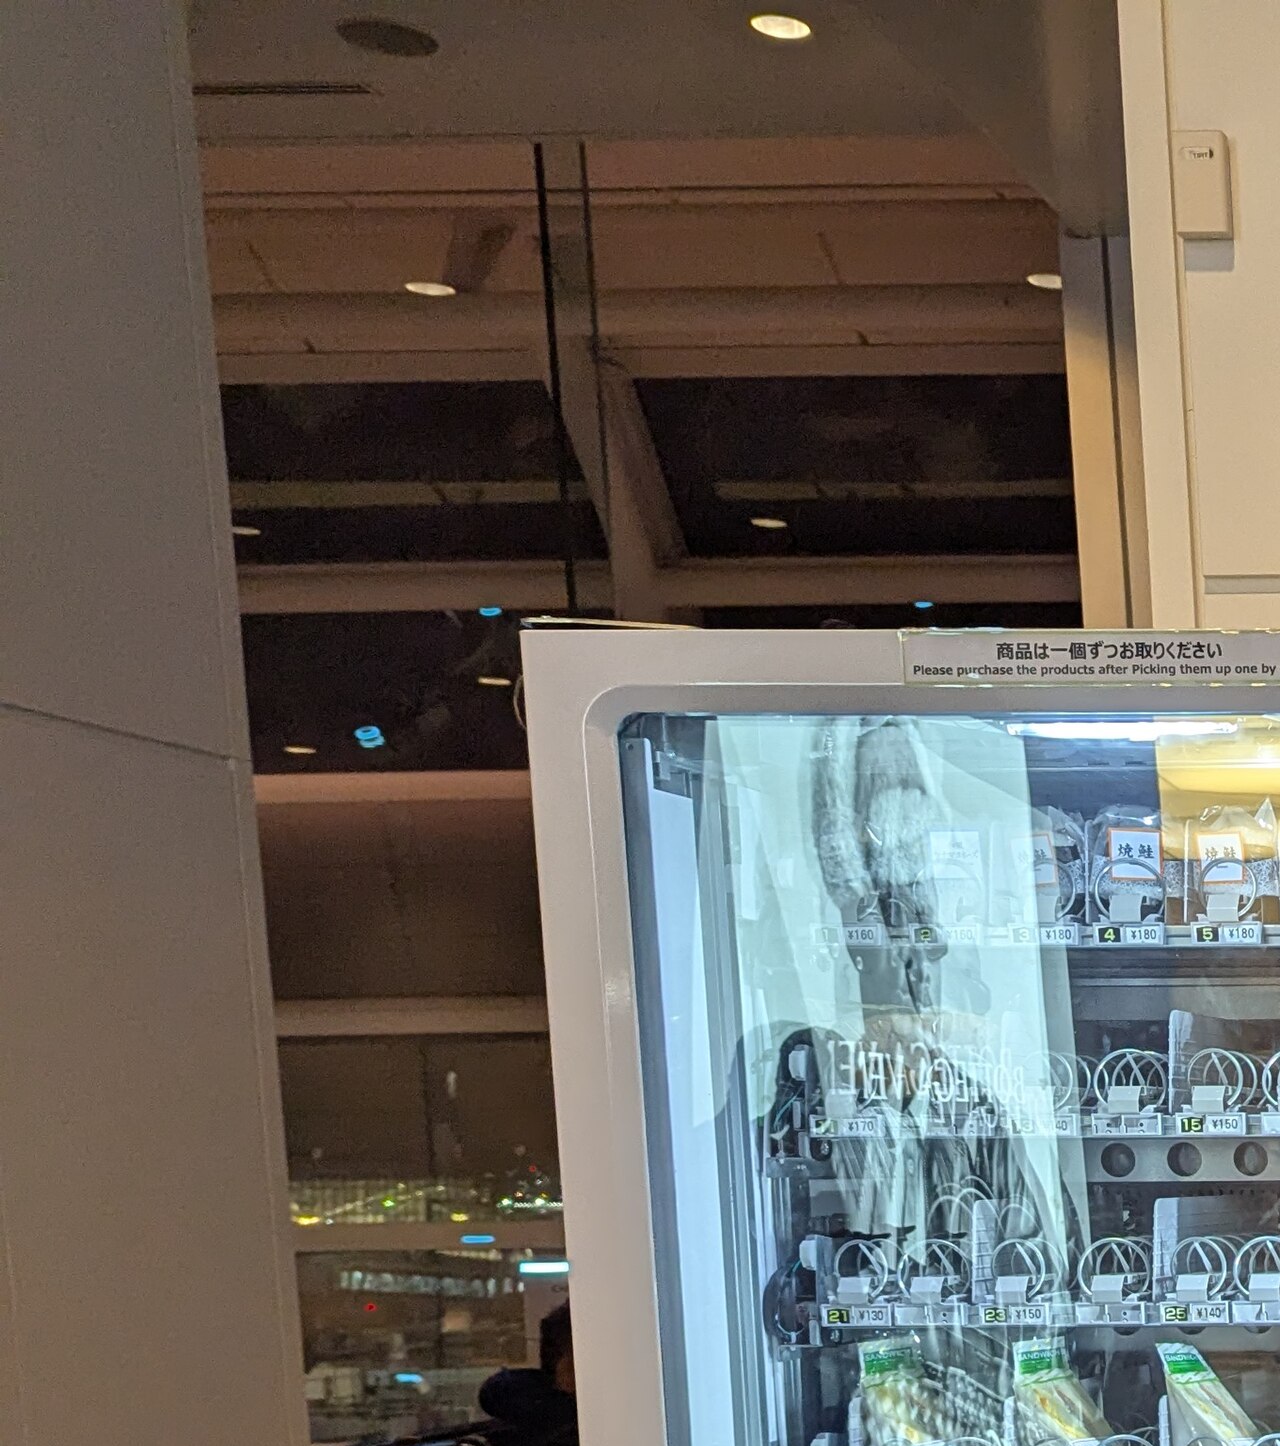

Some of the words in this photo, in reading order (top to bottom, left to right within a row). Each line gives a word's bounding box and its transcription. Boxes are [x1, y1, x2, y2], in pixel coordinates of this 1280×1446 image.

[996, 641, 1223, 660] 商品は一個ずつお取りください
[913, 665, 953, 675] Please
[957, 665, 1013, 678] purchase
[1017, 665, 1037, 676] the
[1041, 664, 1095, 677] products
[1099, 664, 1128, 675] after
[1132, 663, 1176, 677] Picking
[1180, 663, 1212, 675] them
[1215, 665, 1231, 677] up
[1235, 665, 1258, 675] one
[1262, 663, 1277, 677] by
[1118, 843, 1154, 859] 焼鮭
[1104, 928, 1115, 941] 4
[1131, 928, 1156, 940] ¥180
[1182, 1119, 1201, 1131] 15
[1212, 1119, 1237, 1129] ¥150
[829, 1308, 849, 1322] 21
[859, 1309, 884, 1321] ¥130
